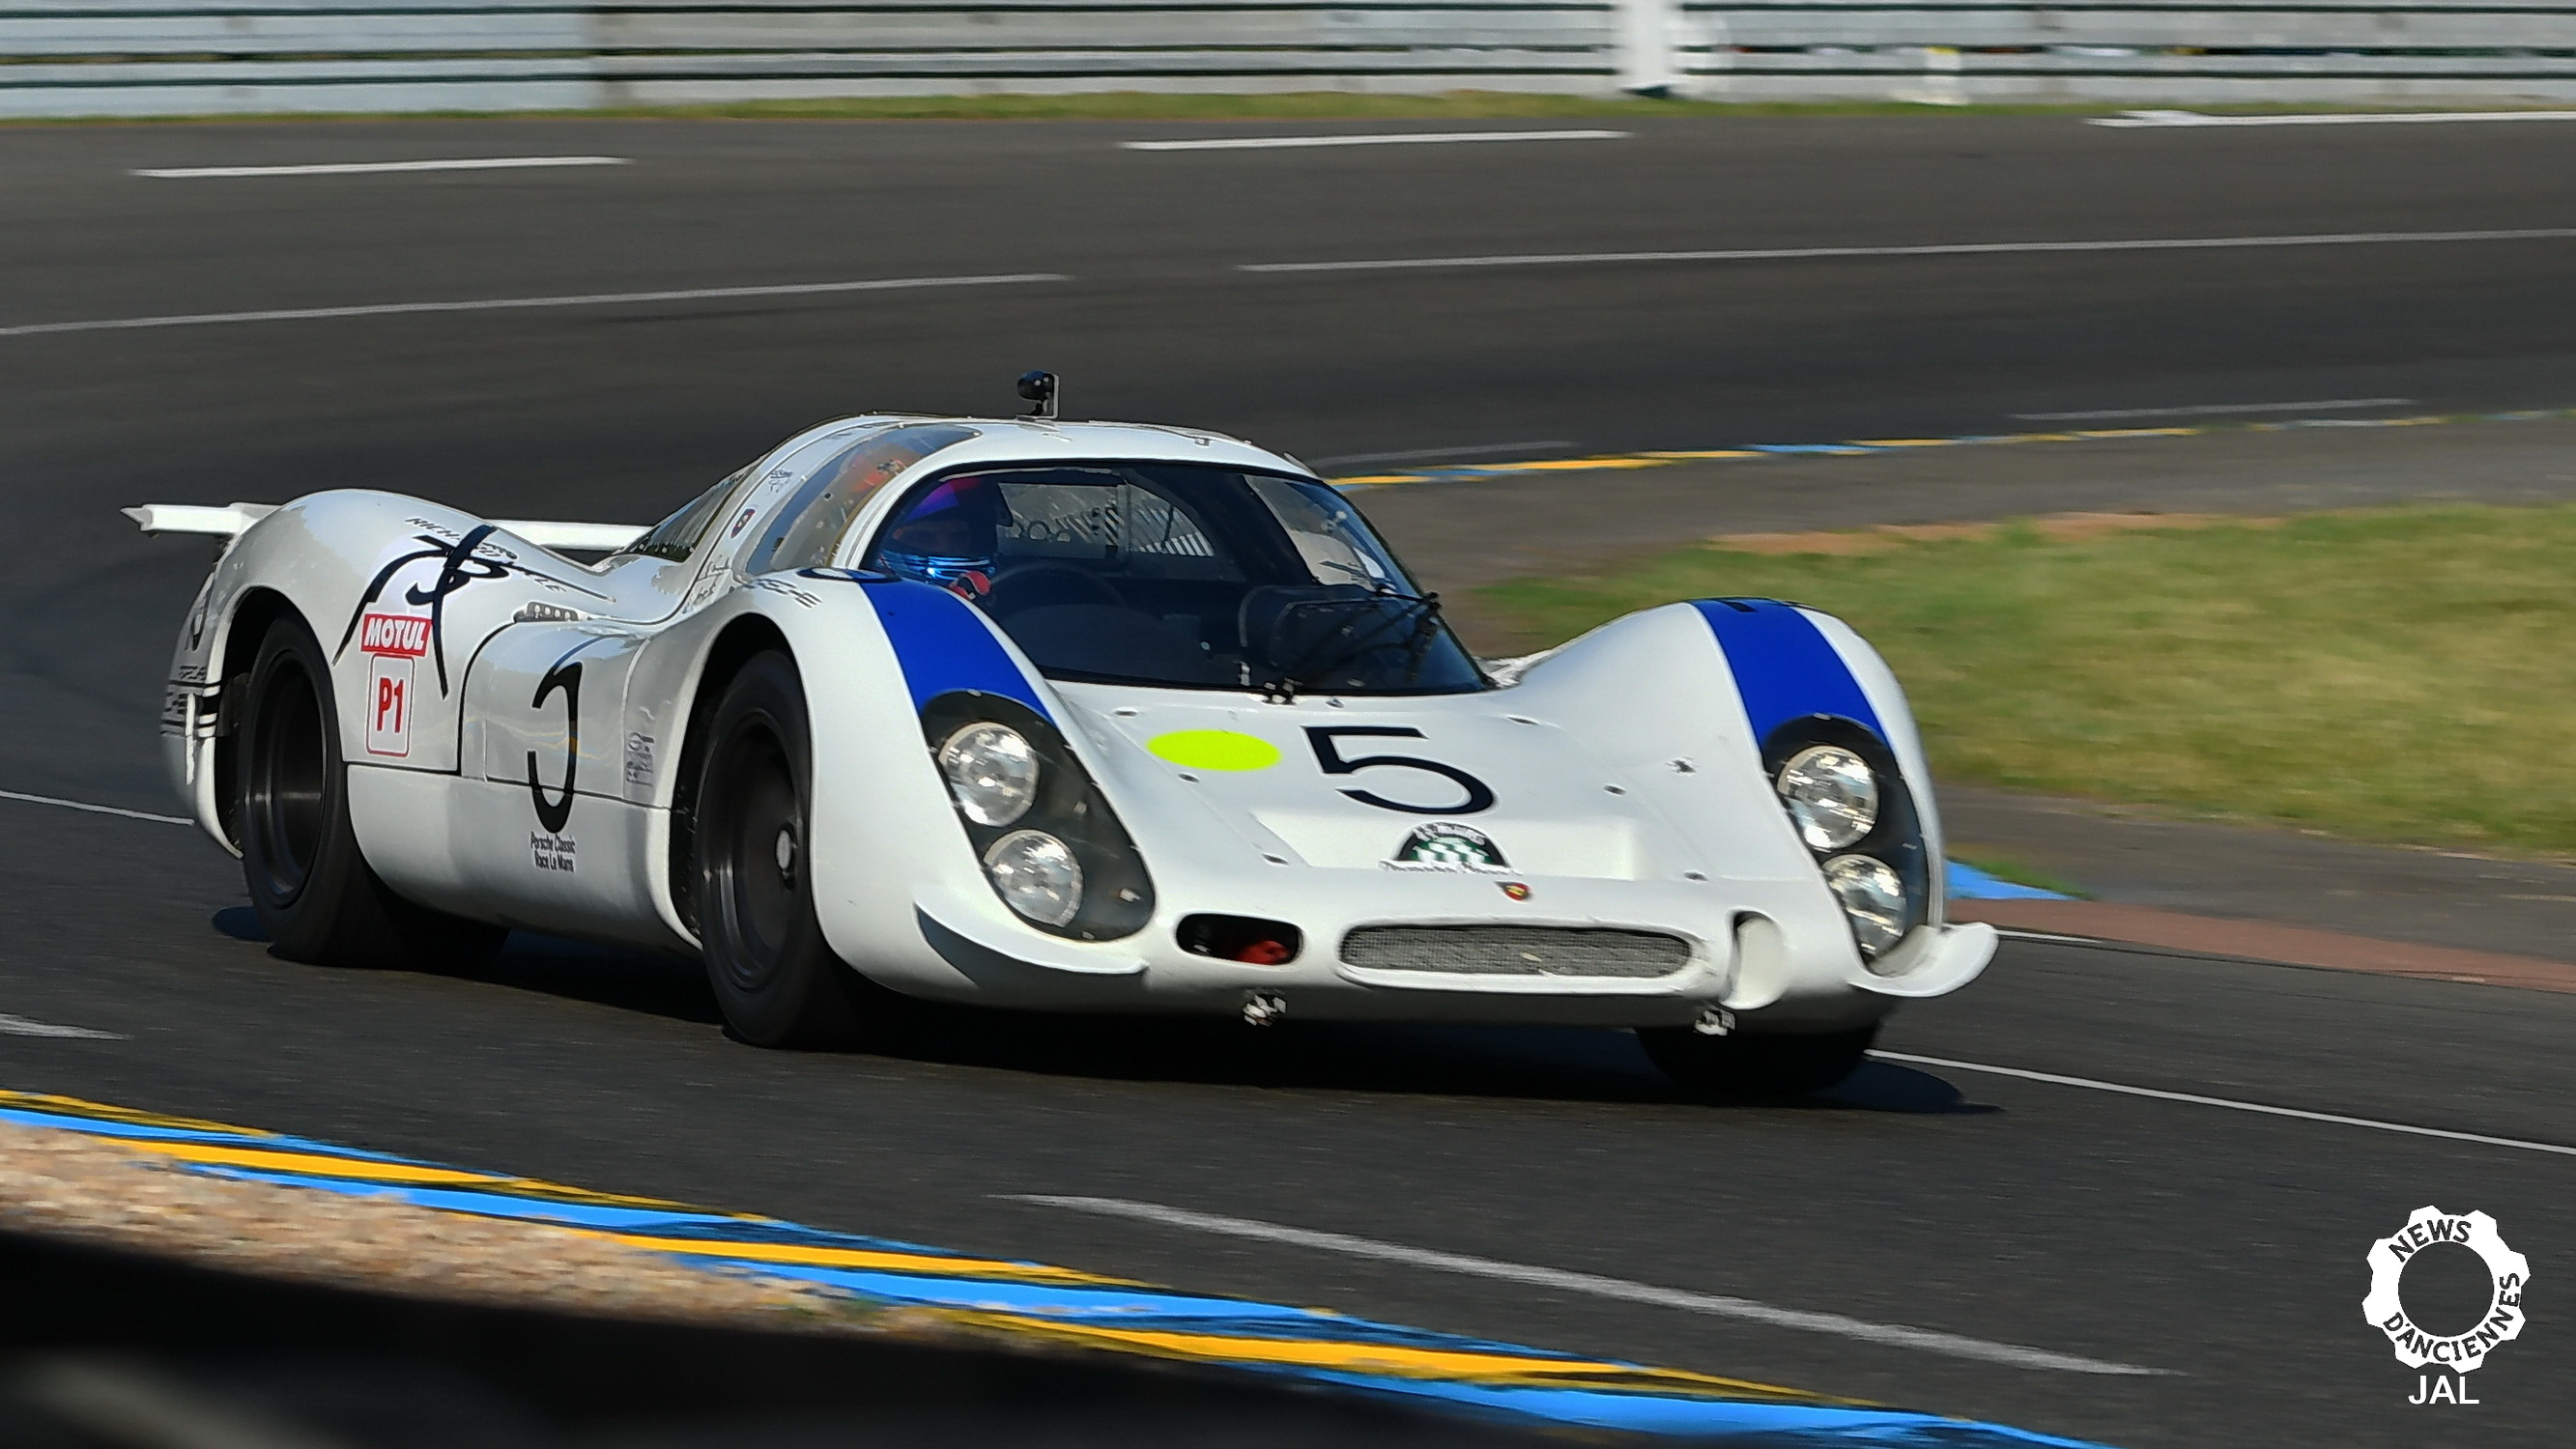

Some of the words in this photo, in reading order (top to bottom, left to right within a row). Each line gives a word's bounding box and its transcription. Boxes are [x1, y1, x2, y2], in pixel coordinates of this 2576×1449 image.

[363, 617, 426, 651] MOTUL
[376, 676, 405, 734] P1
[1301, 725, 1495, 815] 5
